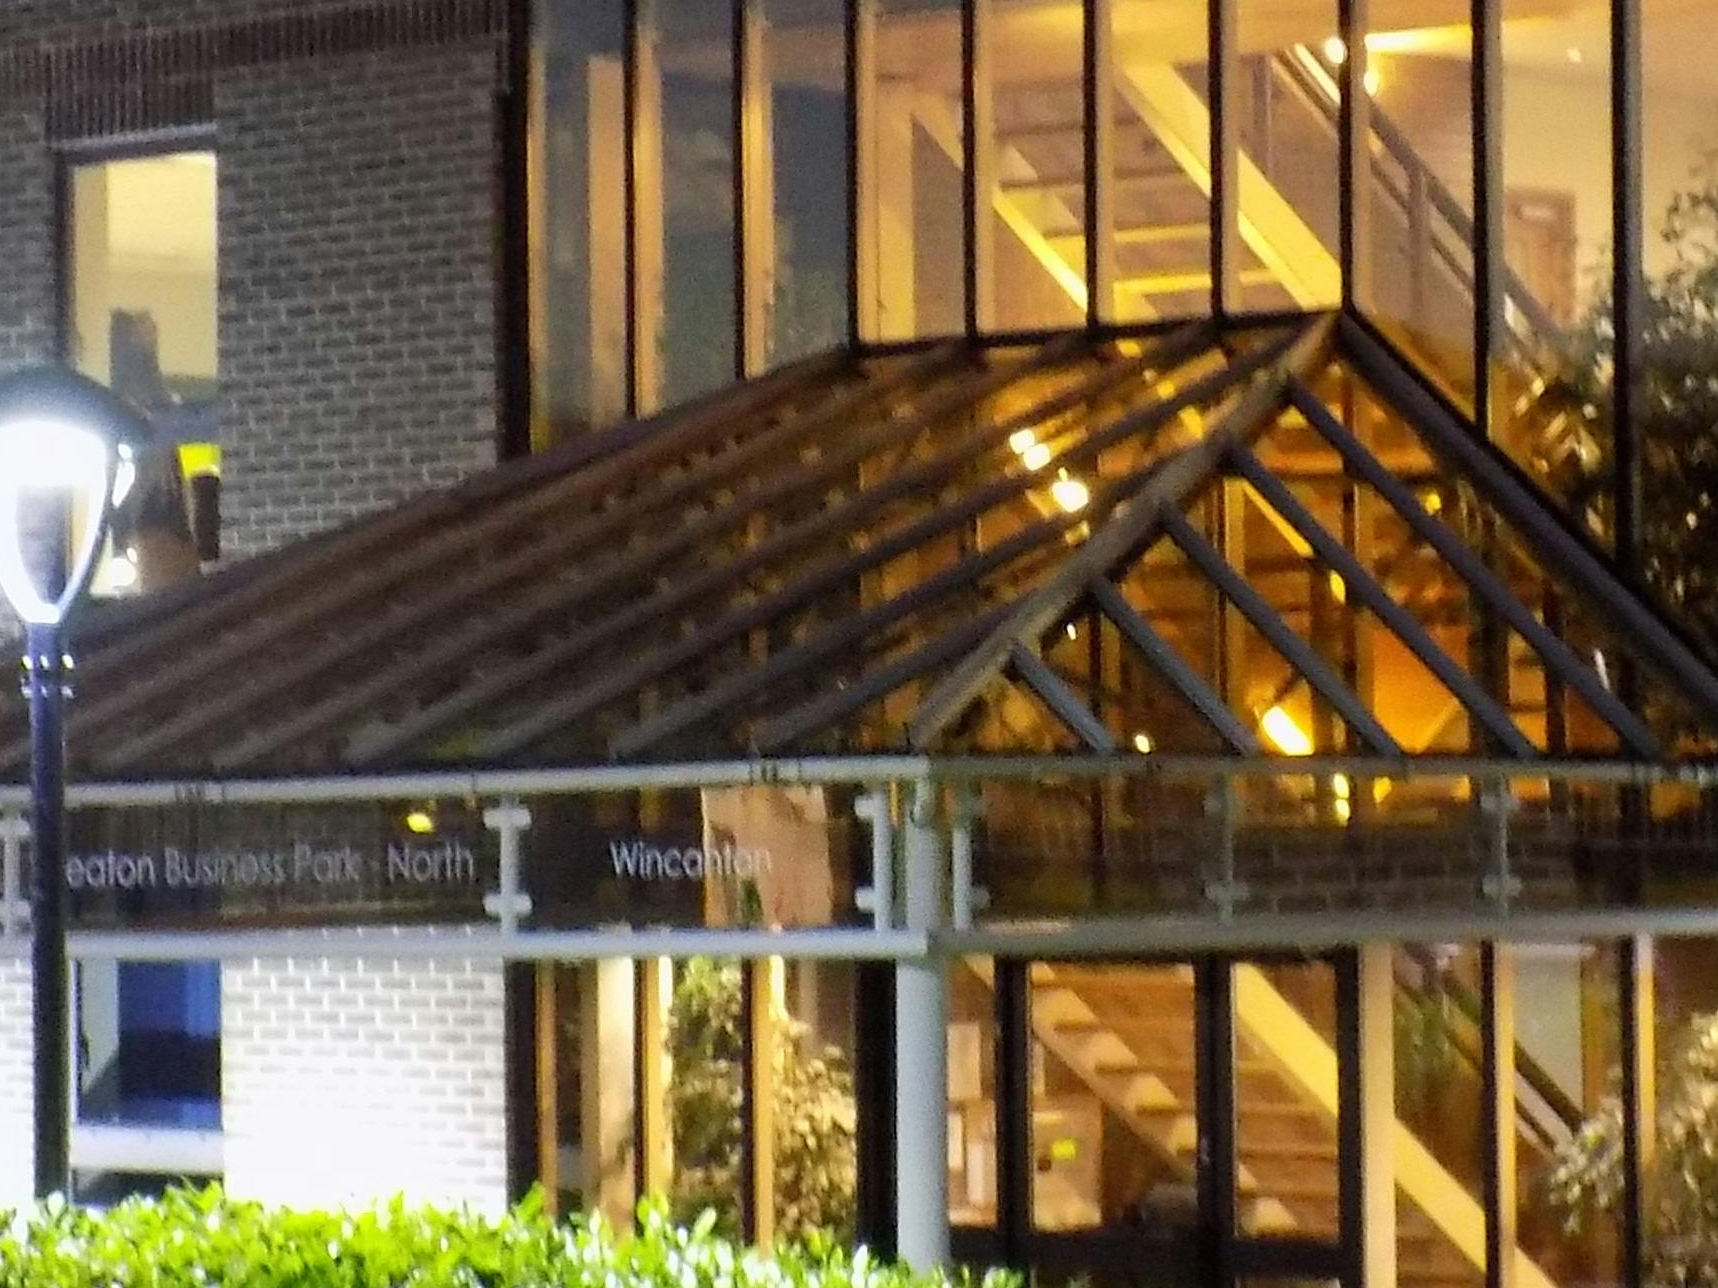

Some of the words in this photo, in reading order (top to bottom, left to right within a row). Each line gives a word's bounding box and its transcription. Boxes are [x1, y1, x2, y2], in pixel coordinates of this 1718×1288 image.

[53, 848, 156, 888] eaton
[163, 846, 284, 886] Business
[293, 842, 361, 883] Park
[387, 841, 475, 882] North
[609, 839, 773, 882] Wincanton
